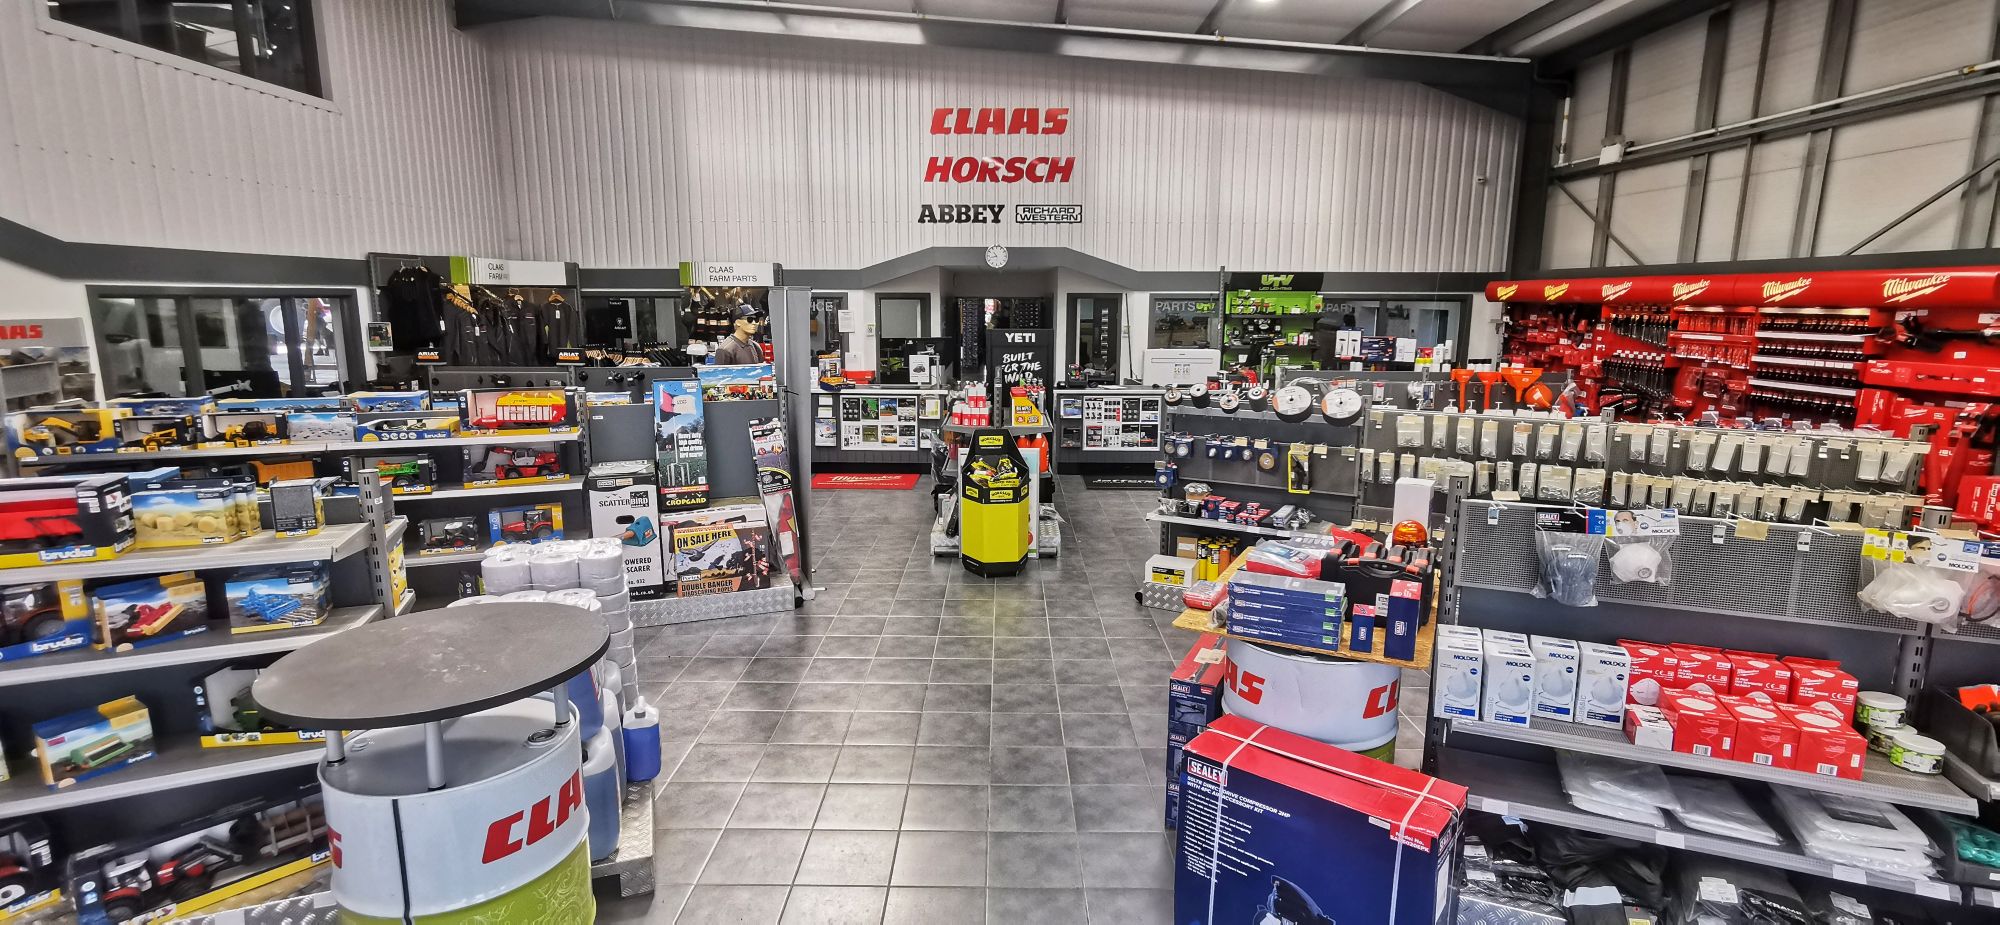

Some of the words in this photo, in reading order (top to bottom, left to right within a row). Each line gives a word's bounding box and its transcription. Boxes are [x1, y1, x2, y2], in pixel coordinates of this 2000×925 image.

[930, 108, 1069, 135] CLAAS
[924, 157, 1076, 183] HORSCH
[918, 204, 1005, 224] ABBEY
[1022, 206, 1076, 214] RICHARD
[1020, 213, 1079, 221] WESTERN
[709, 266, 734, 274] CLAAS
[1601, 281, 1633, 298] Milwaukee
[1671, 279, 1711, 297] Milwaukee
[1761, 277, 1812, 298] Milwaukee
[1882, 274, 1952, 298] Milwaukee
[1155, 302, 1196, 312] PARTS
[1005, 332, 1036, 342] YETI
[1002, 352, 1035, 363] BUILT
[1020, 361, 1042, 371] THE
[666, 497, 707, 506] CROPGARD
[676, 537, 689, 549] ON
[690, 534, 710, 546] SALE
[711, 530, 732, 540] HERE
[40, 549, 95, 561] bruder
[626, 564, 651, 573] SCARER
[1948, 562, 1976, 571] MOLDEX
[681, 581, 707, 591] DOUBLE
[707, 579, 733, 588] BANGER
[32, 634, 84, 652] bruder
[1453, 654, 1479, 662] MOLDEX
[1549, 652, 1575, 660] MOLDEX
[1599, 659, 1627, 668] MOLDEX
[1172, 684, 1189, 693] SEALEY
[1187, 781, 1201, 790] WITH
[1222, 794, 1253, 811] ACCESSORY
[1253, 806, 1264, 814] KIT
[1239, 795, 1277, 814] COMPRESSOR
